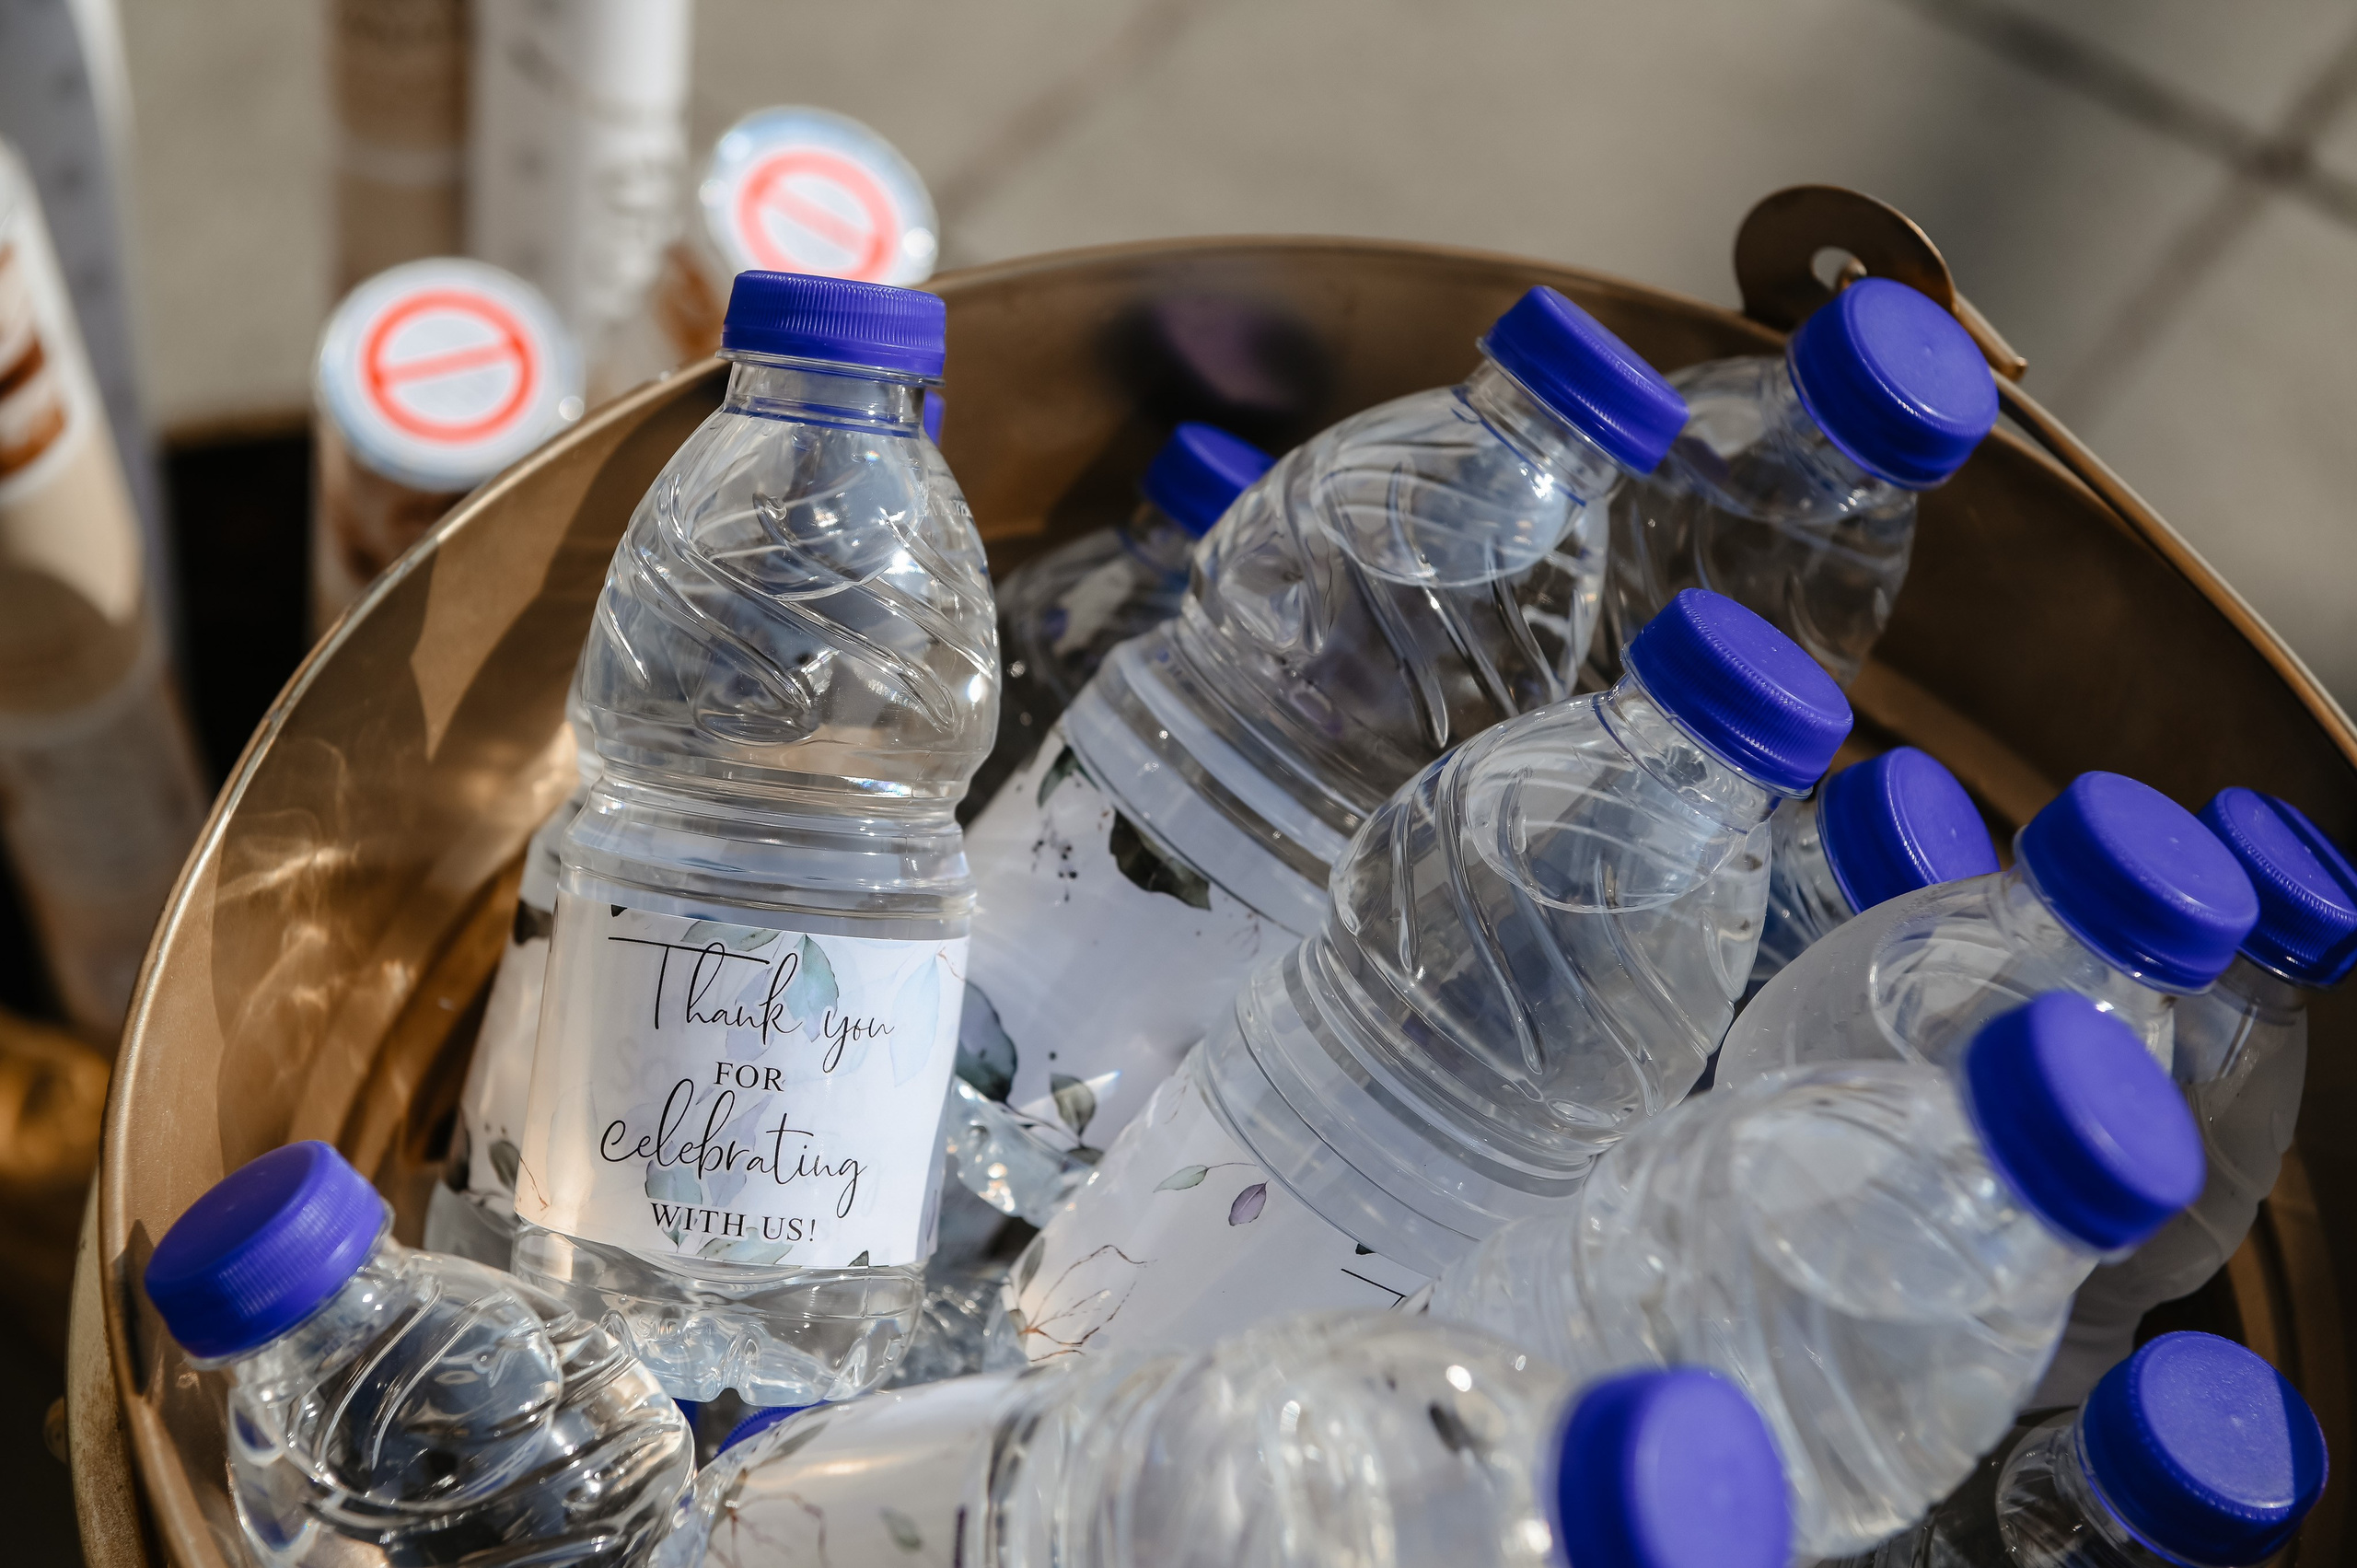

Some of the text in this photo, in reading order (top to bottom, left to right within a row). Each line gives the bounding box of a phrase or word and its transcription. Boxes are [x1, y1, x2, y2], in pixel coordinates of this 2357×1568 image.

[608, 936, 895, 1074] Thank you
[714, 1061, 785, 1093] FOR
[650, 1202, 817, 1243] WITH US!
